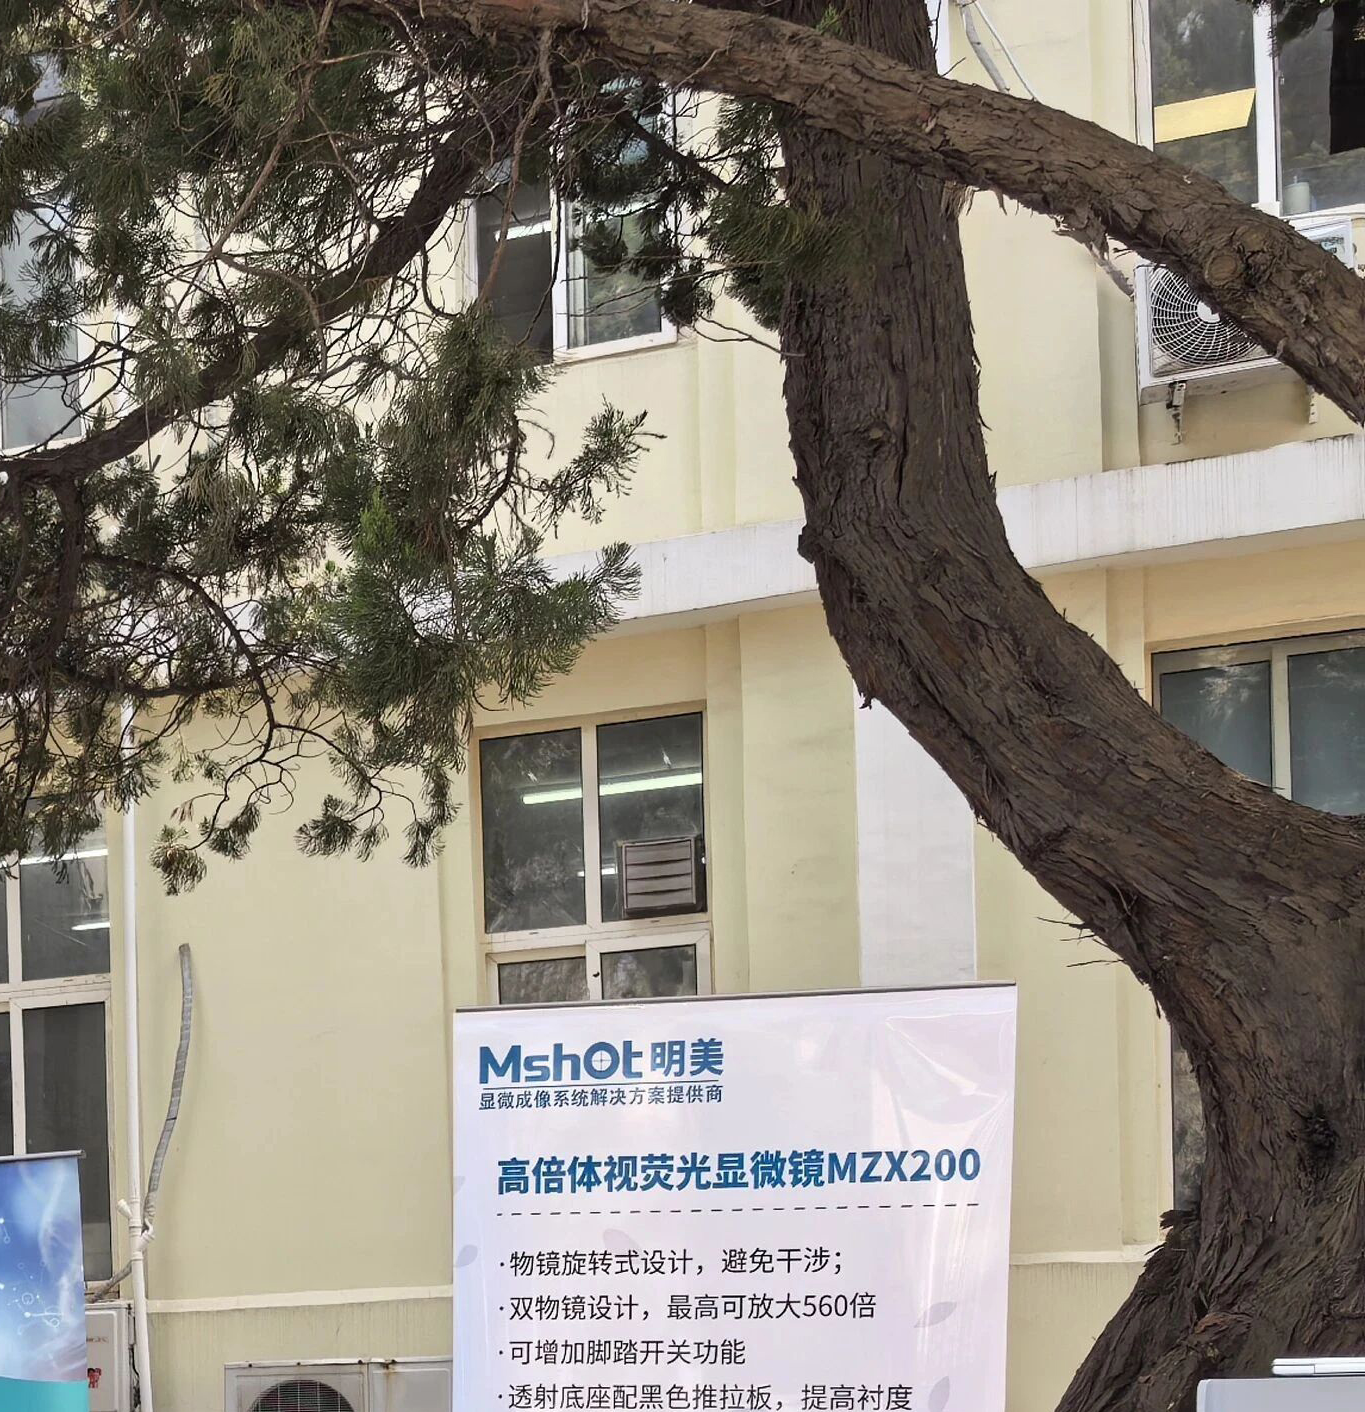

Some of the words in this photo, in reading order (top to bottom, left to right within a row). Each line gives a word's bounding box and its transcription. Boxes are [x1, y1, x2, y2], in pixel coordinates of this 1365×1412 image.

[650, 1037, 724, 1078] 明美
[478, 1084, 724, 1111] 显微成像系统解决方案提供商
[497, 1148, 981, 1196] 高倍体视荧光显微镜MZX200
[508, 1291, 877, 1322] 双物镜设计，最高可放大560倍
[508, 1338, 747, 1366] 可增加脚踏开关功能
